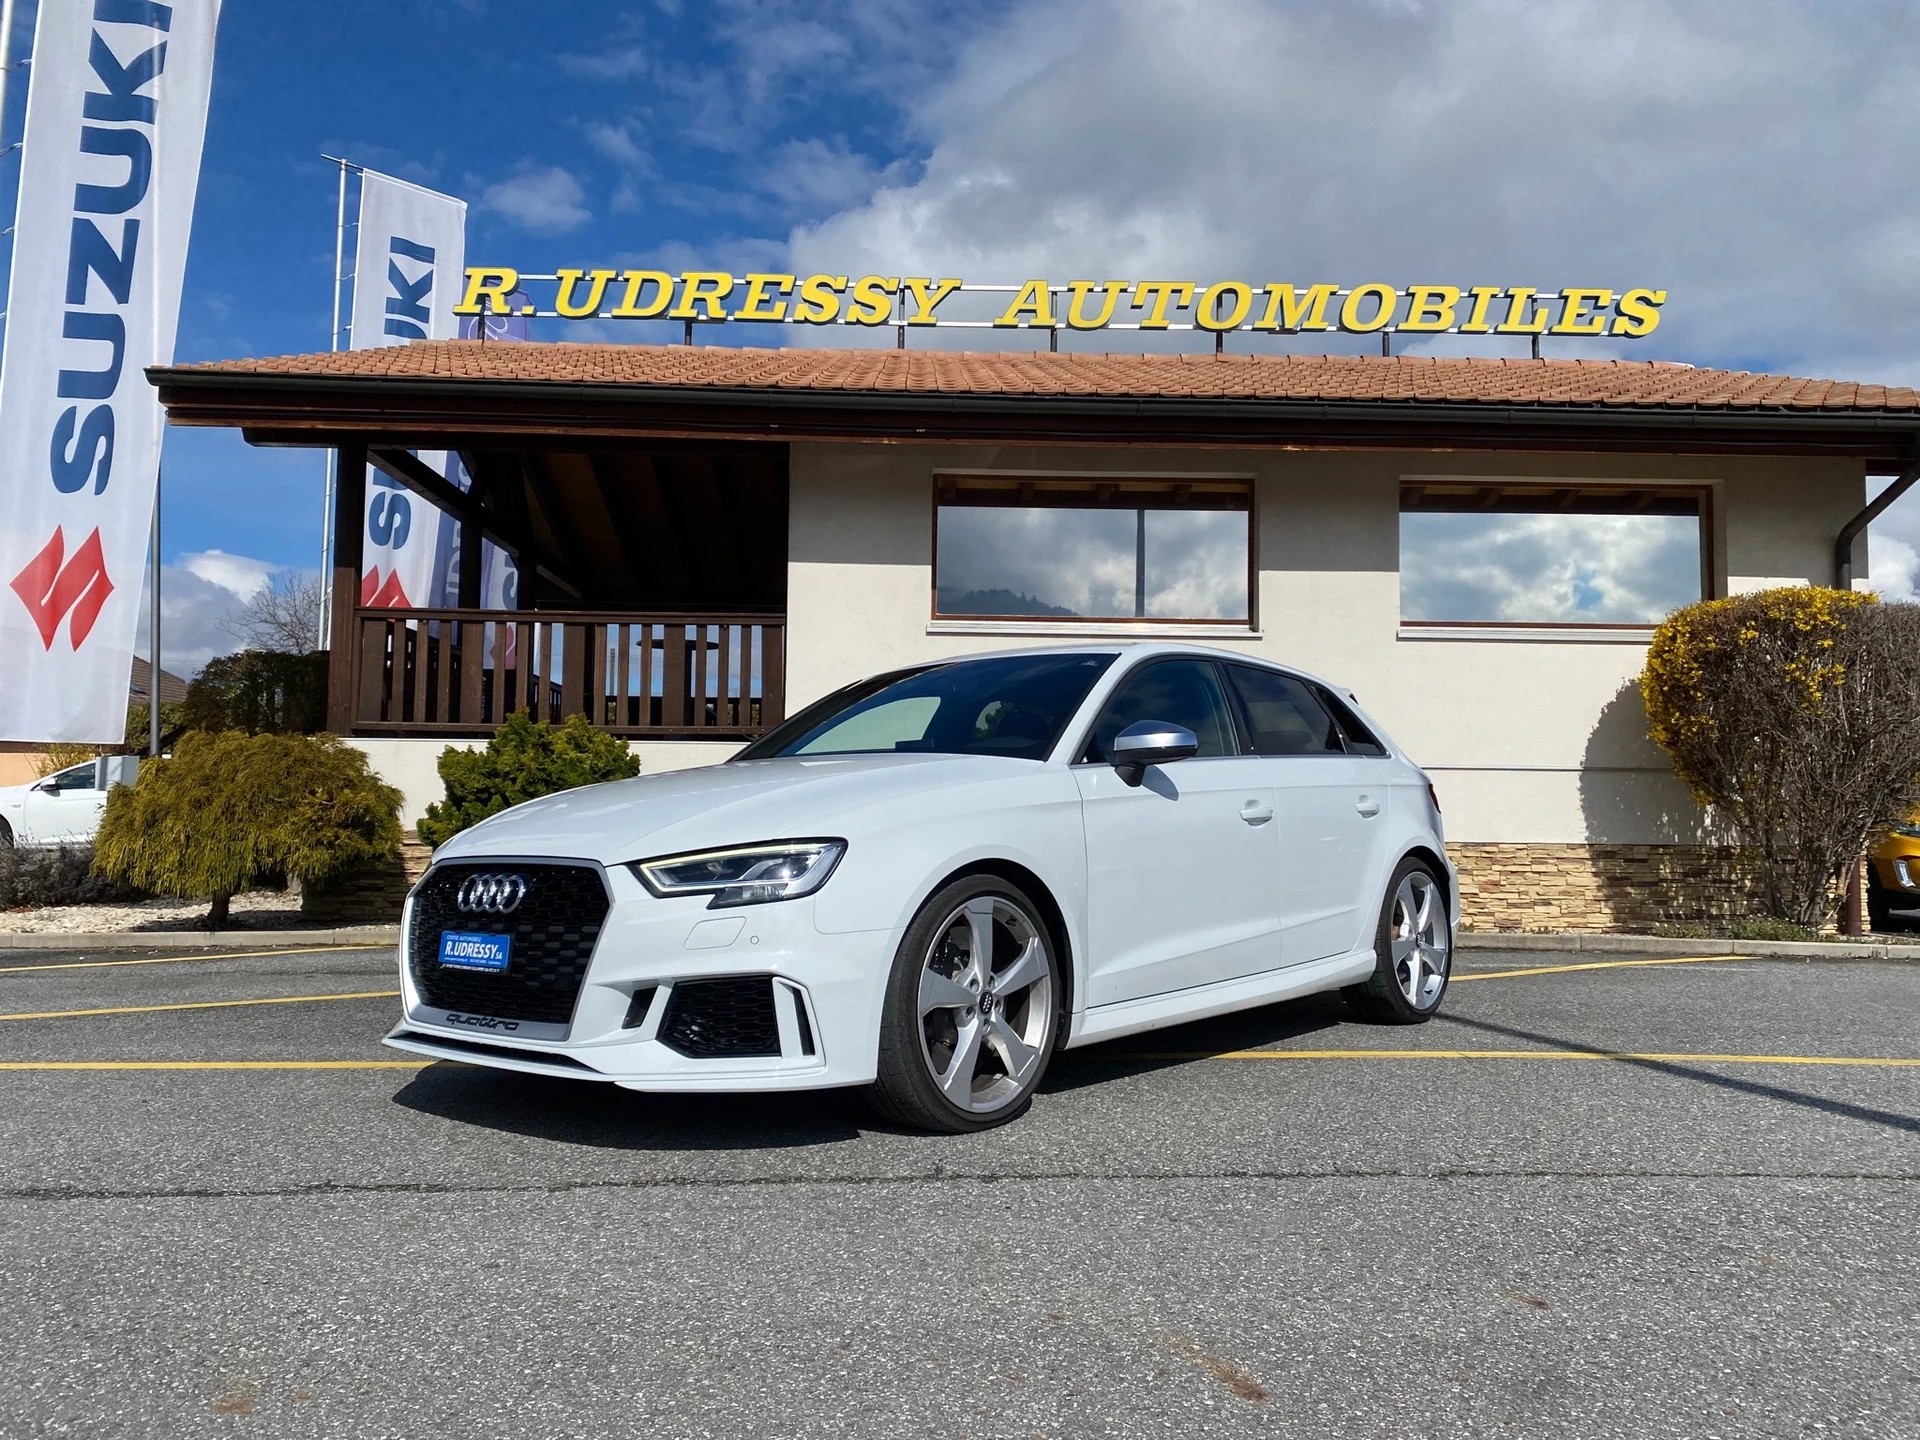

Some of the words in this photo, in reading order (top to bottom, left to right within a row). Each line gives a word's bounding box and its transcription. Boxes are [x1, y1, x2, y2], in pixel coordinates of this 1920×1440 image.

[50, 0, 173, 496] SUZUKI
[994, 280, 1666, 337] AUTOMOBILES
[445, 941, 499, 959] R.UDRESSY
[495, 951, 503, 960] SA
[446, 1013, 519, 1031] quattro
